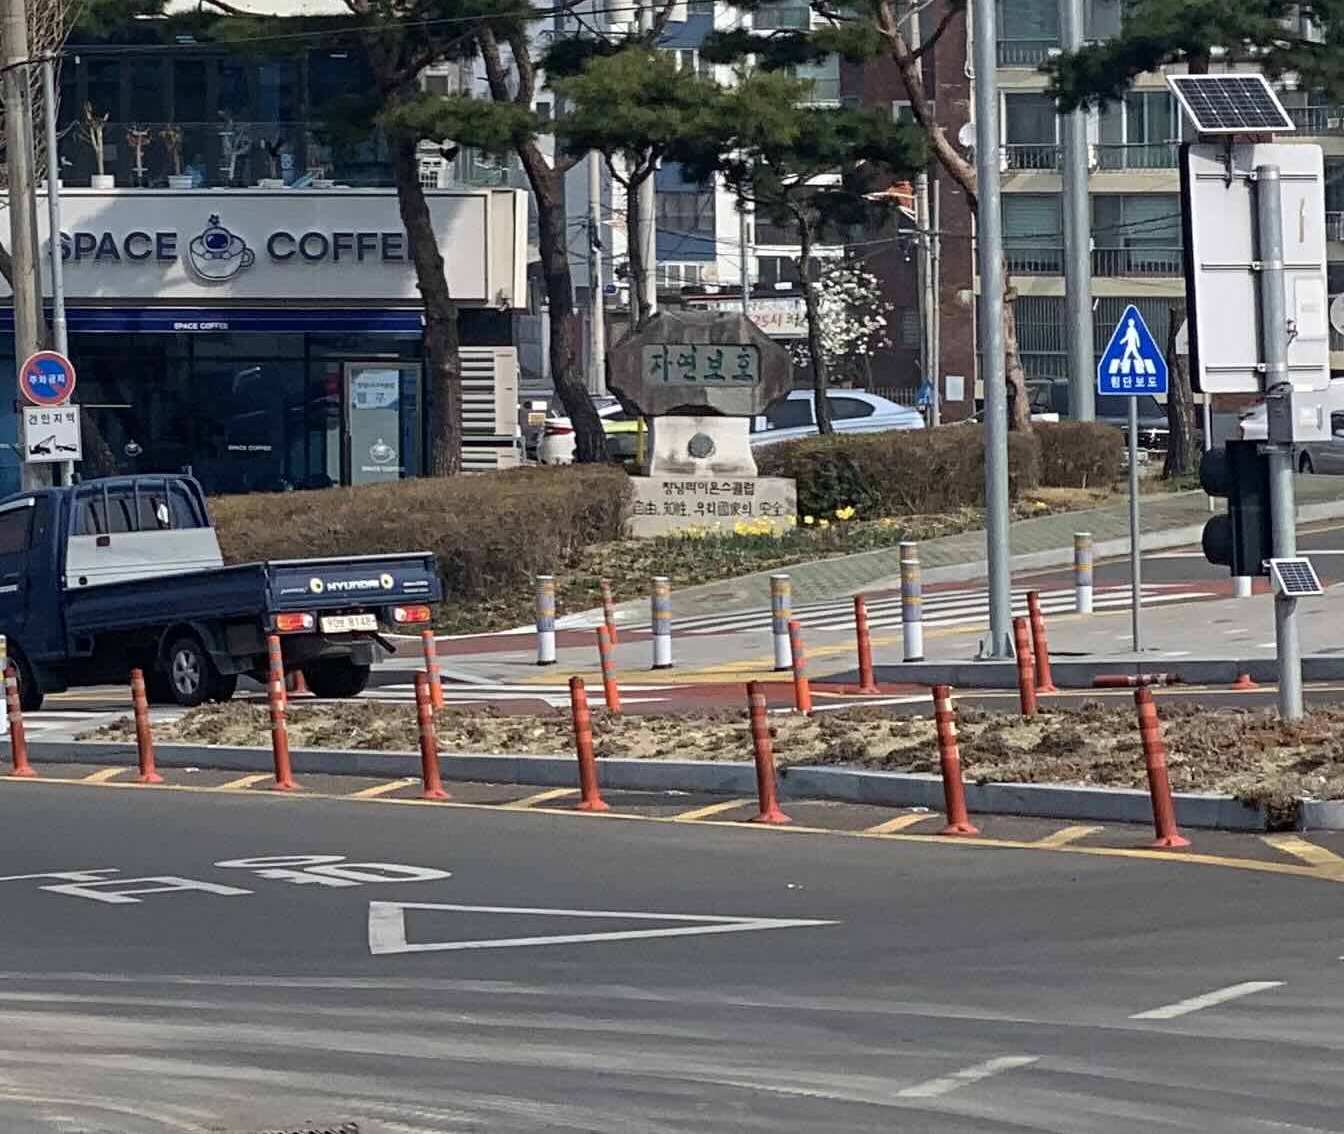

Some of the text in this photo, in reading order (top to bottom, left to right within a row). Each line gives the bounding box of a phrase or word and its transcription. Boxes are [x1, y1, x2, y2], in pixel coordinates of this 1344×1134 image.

[649, 344, 754, 382] 자연보호
[29, 373, 66, 385] 주차금지
[1111, 375, 1158, 388] 횡단보도
[28, 413, 76, 425] 견인지역
[327, 579, 380, 591] HYUNDAI
